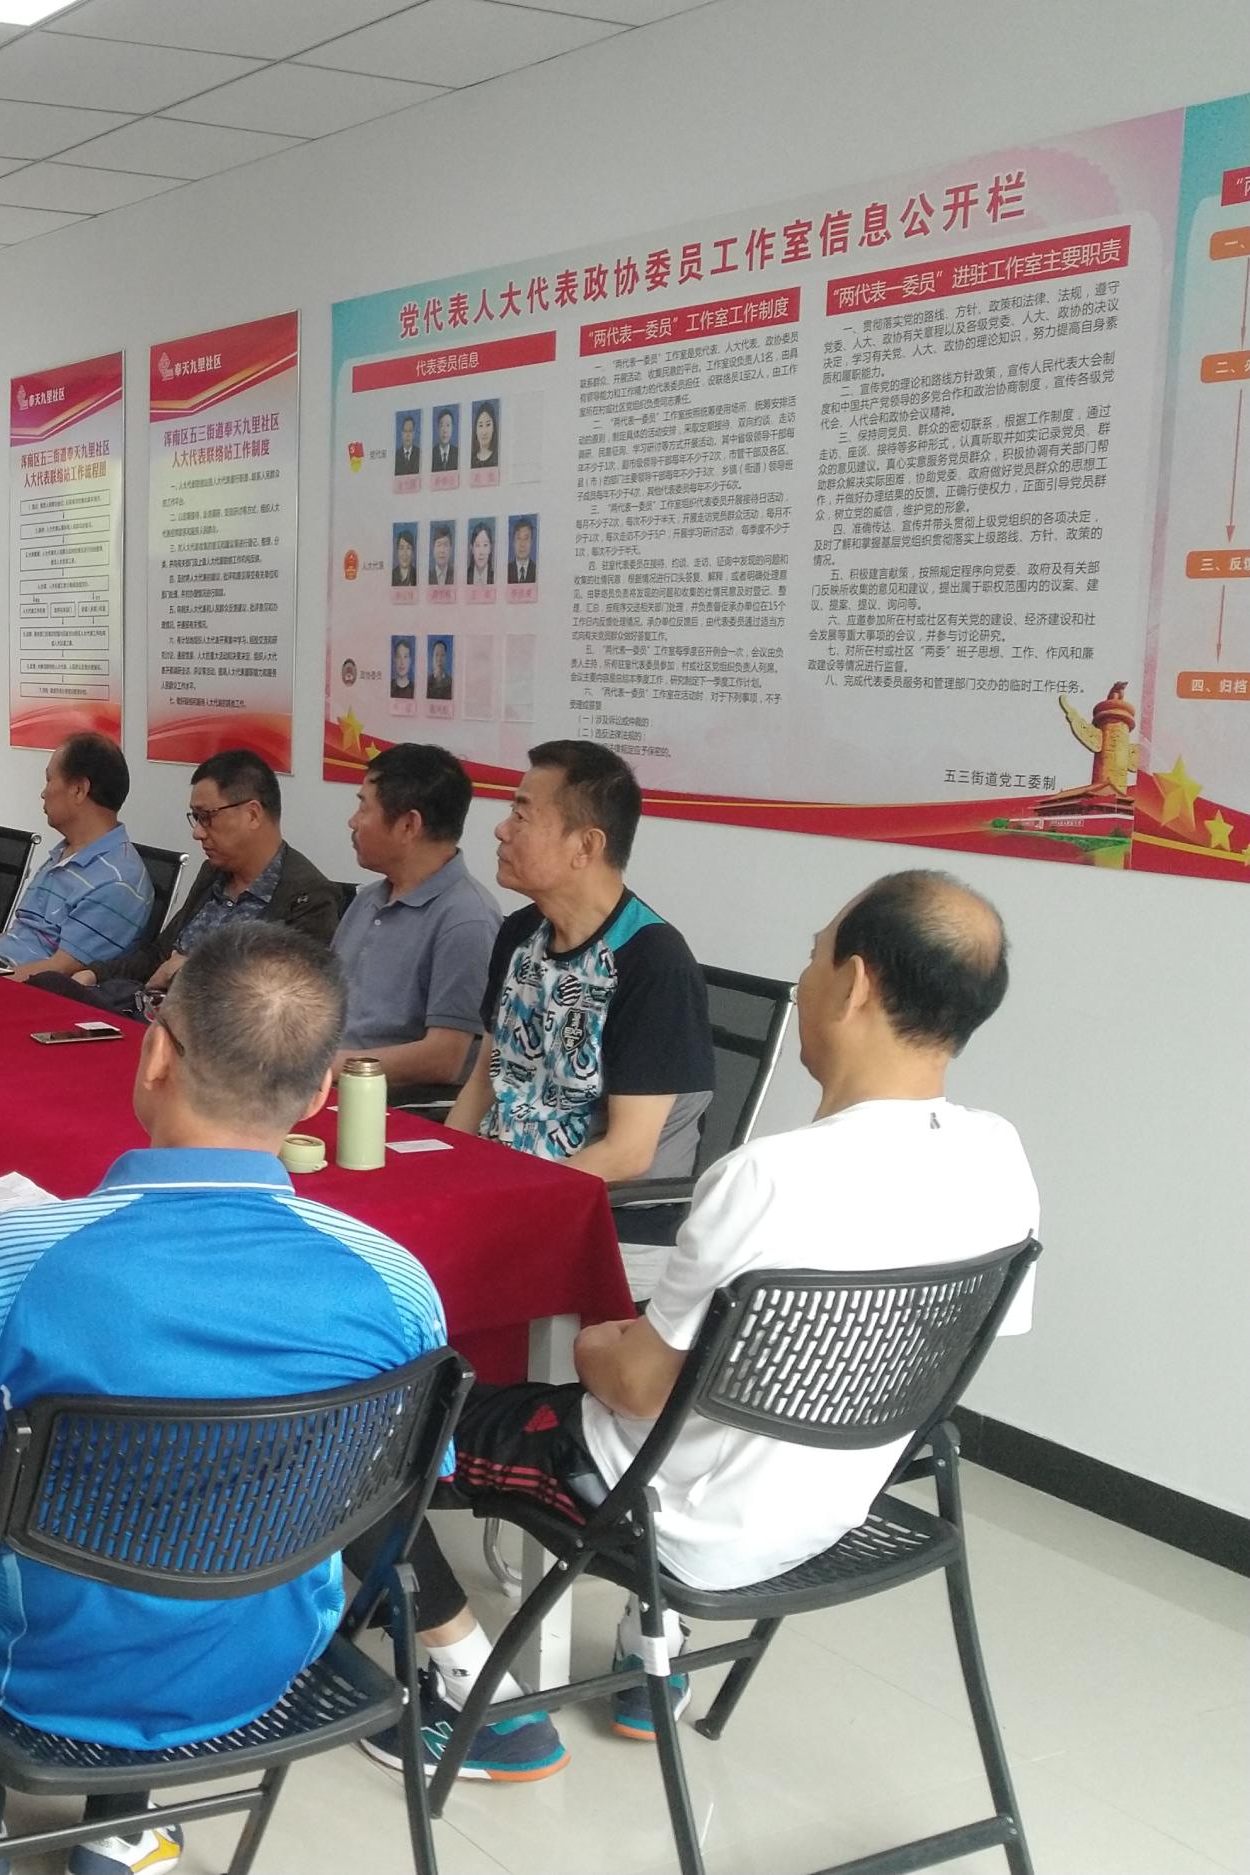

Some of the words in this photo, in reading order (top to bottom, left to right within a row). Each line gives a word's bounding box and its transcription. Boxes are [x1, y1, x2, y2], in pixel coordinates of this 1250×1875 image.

[399, 171, 1027, 339] 党代表人大代表政协委员工作室信息公开栏
[174, 354, 222, 376] 奉天九里社区
[416, 352, 479, 377] 代表委员信息
[29, 387, 65, 407] 奉天九里社区
[164, 413, 279, 447] 浑南区五三街道奉天九里社区
[21, 440, 110, 469] 浑南区五三街道奉天九里社区
[172, 439, 270, 468] 人大代表联络站工作制度
[24, 461, 106, 488] 人大代表联络站工作流程图
[1191, 679, 1248, 693] 四、归档
[944, 769, 1055, 790] 五三街道党工委制
